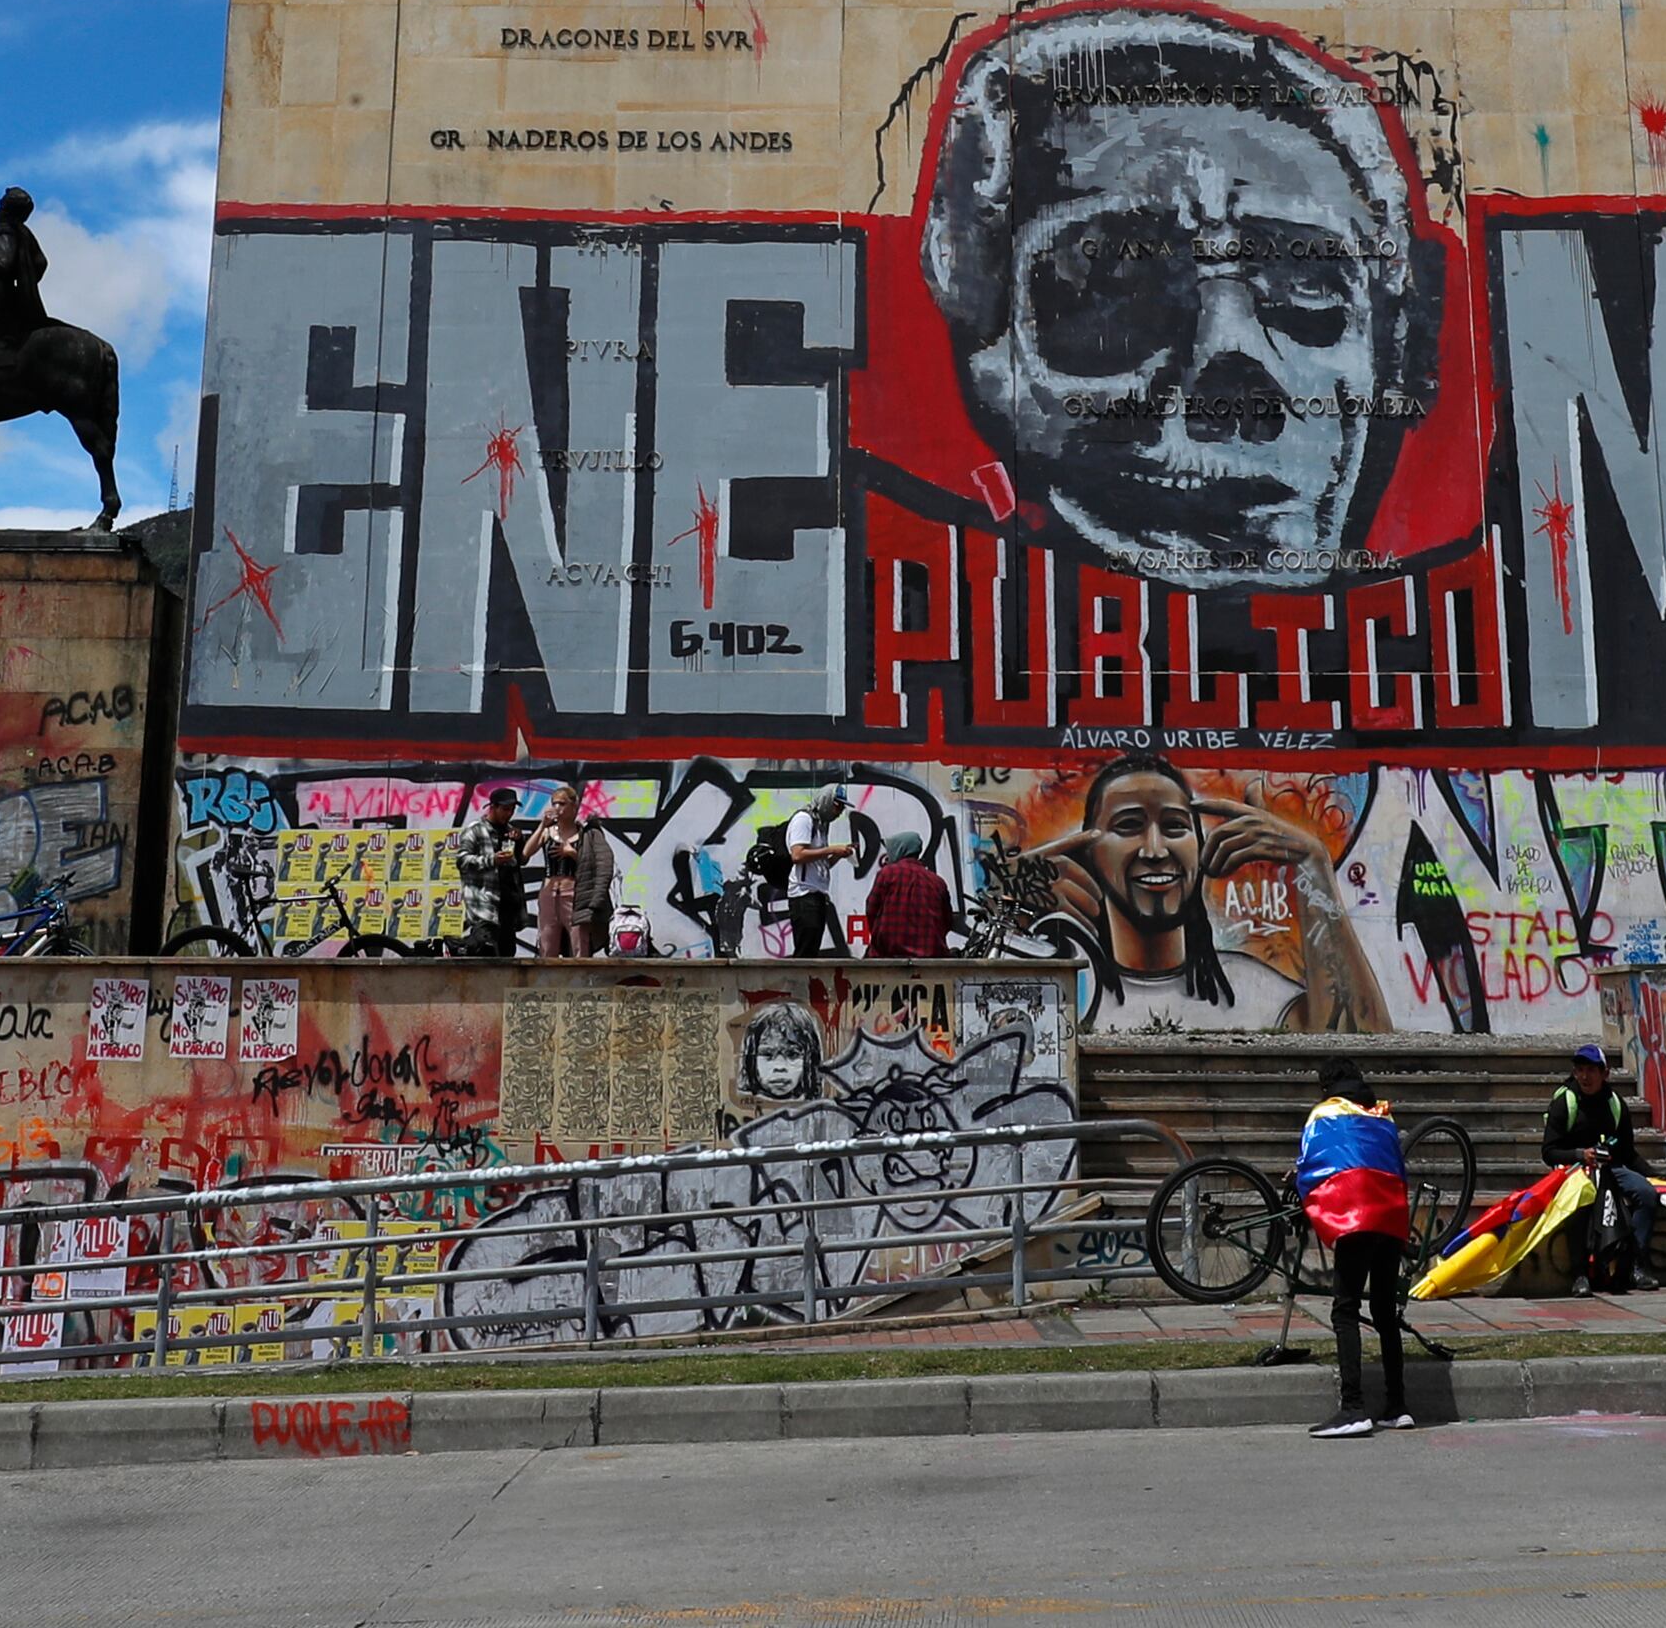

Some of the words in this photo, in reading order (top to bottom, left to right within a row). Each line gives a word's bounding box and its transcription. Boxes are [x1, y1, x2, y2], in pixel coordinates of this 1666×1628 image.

[500, 28, 639, 49] DRAGONES
[648, 28, 695, 49] DEL
[704, 29, 753, 50] SVR
[1053, 86, 1224, 108] GRANADEROS
[1233, 86, 1263, 107] DE
[1270, 86, 1304, 107] LA
[617, 131, 648, 151] DE
[657, 131, 702, 151] LOS
[710, 132, 793, 152] ANDES
[565, 339, 654, 362] PIVRA
[1064, 393, 1244, 419] GRANADEROS
[1251, 393, 1283, 418] DE
[1289, 394, 1426, 419] COLOMBIA
[537, 450, 664, 471] TRVJILLO
[1227, 550, 1258, 573] DE
[1267, 549, 1401, 574] COLOMBIA
[1061, 721, 1151, 749] ÁLVARO
[1164, 727, 1239, 749] URIBE
[1259, 725, 1337, 750] VÉLEZ
[100, 1044, 141, 1058] PARACO
[182, 1041, 224, 1055] PARACO
[83, 1216, 118, 1253] ALTO
[258, 1310, 280, 1332] ALTO
[250, 1400, 360, 1457] DUQUE
